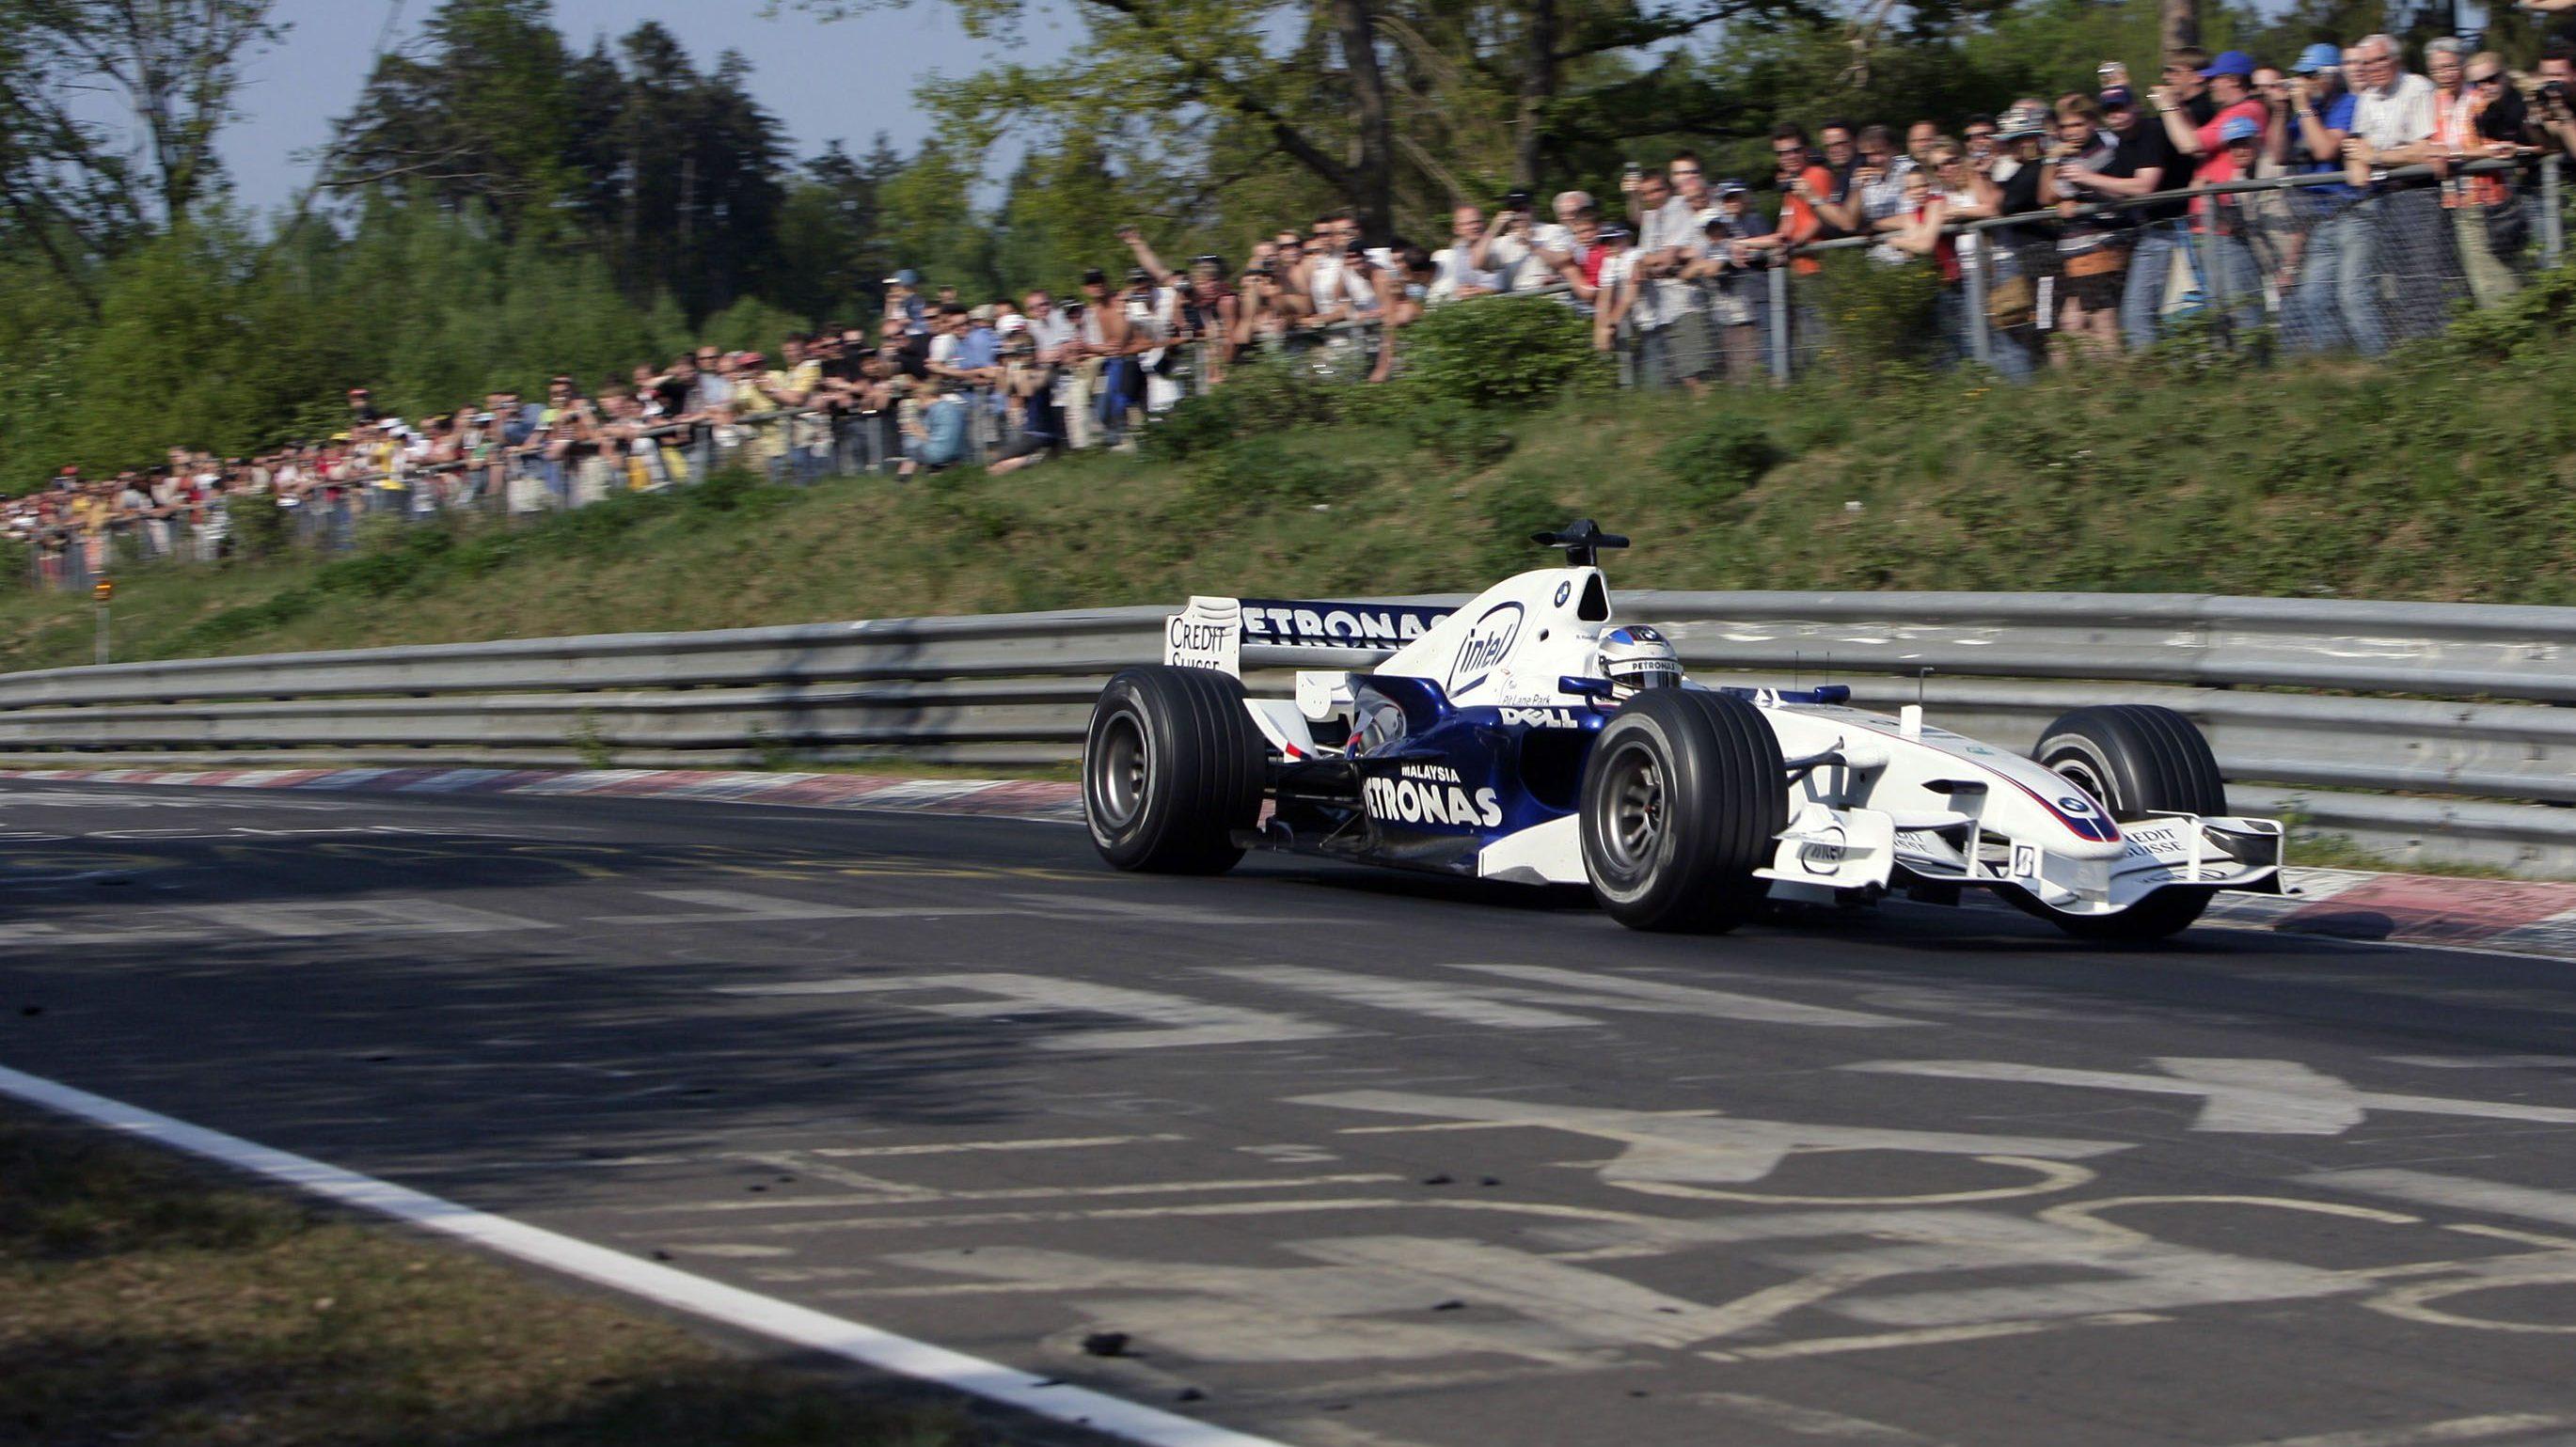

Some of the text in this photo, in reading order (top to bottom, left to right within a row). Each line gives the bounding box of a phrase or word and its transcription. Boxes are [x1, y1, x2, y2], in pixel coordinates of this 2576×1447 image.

[1171, 618, 1225, 653] CREDIT
[1241, 607, 1451, 649] ETRONA
[1460, 623, 1513, 673] intel
[1632, 661, 1676, 671] PETRONAS
[1533, 694, 1551, 706] Park
[1498, 707, 1578, 729] DELL
[1401, 764, 1461, 783] MALAYSIA
[2124, 828, 2176, 844] EDIT
